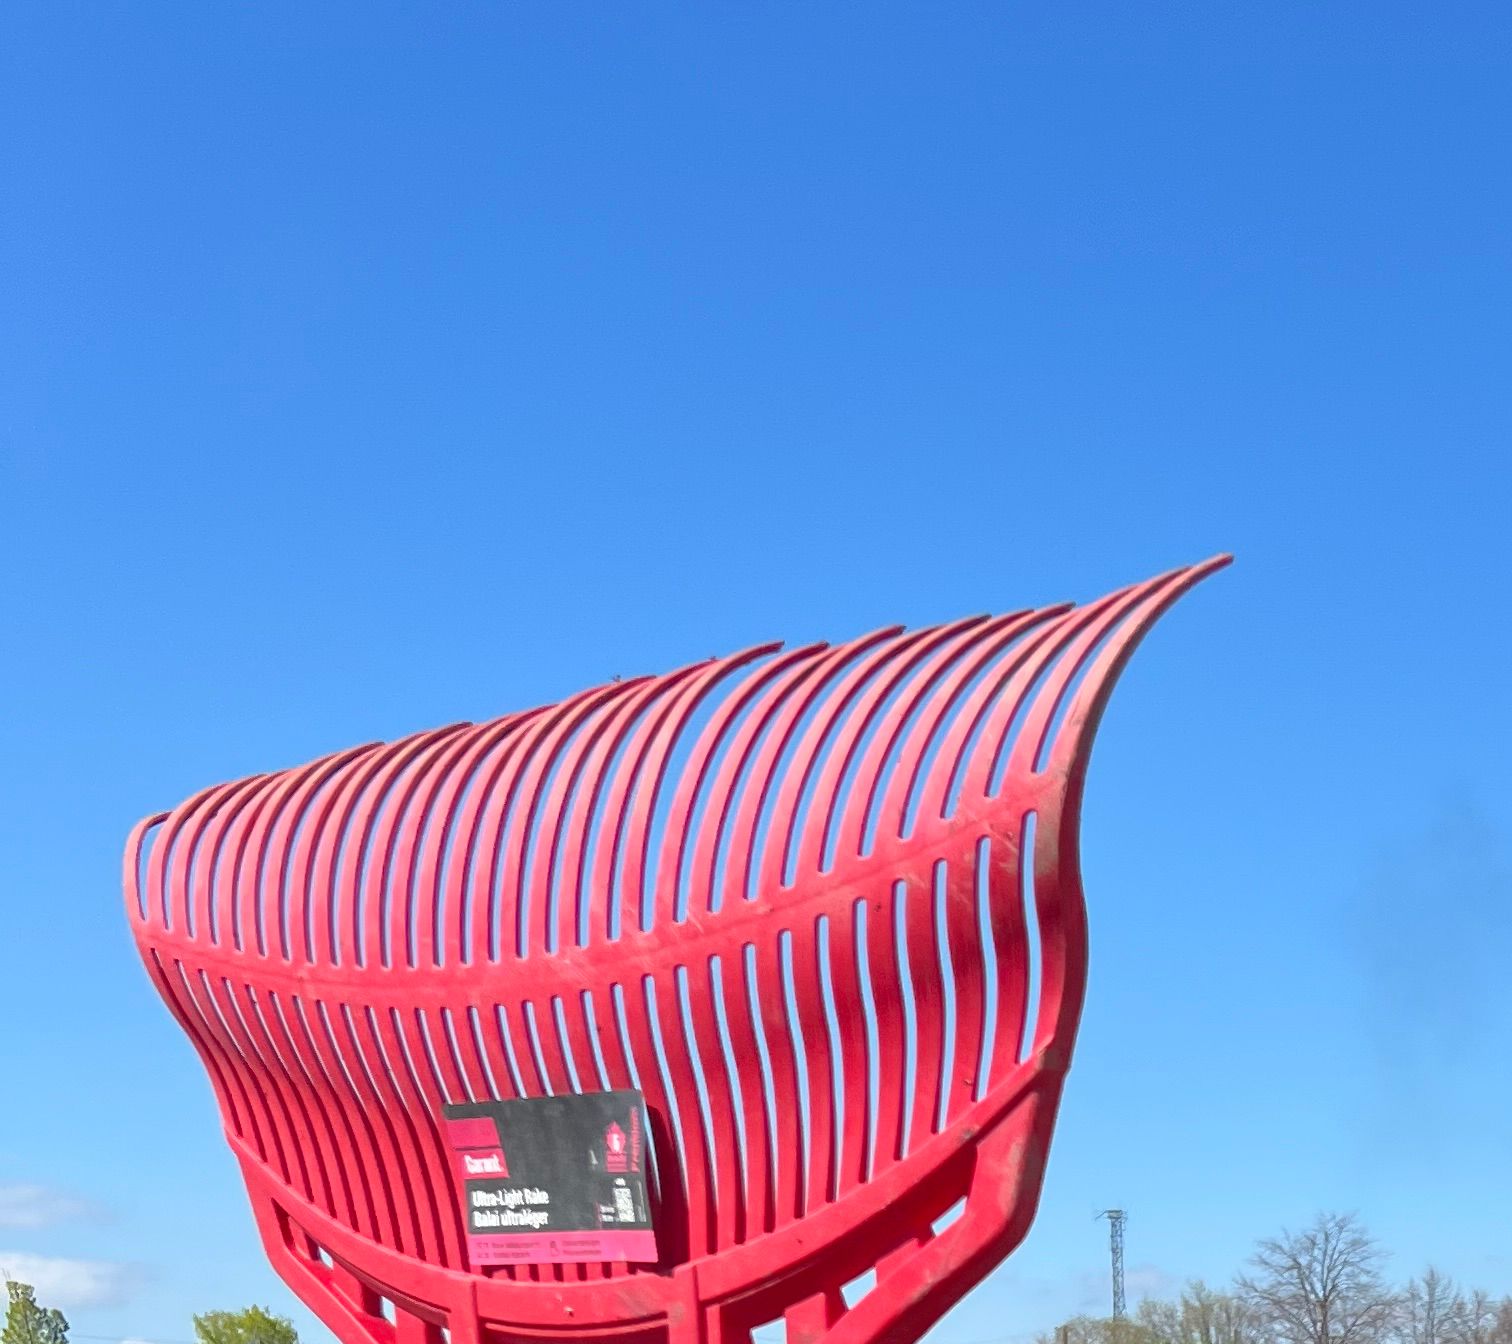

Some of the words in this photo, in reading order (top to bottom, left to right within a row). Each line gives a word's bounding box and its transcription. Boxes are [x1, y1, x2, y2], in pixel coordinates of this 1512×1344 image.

[472, 1188, 524, 1209] Ultra-Light
[523, 1187, 549, 1205] Rake
[473, 1210, 500, 1227] Balai
